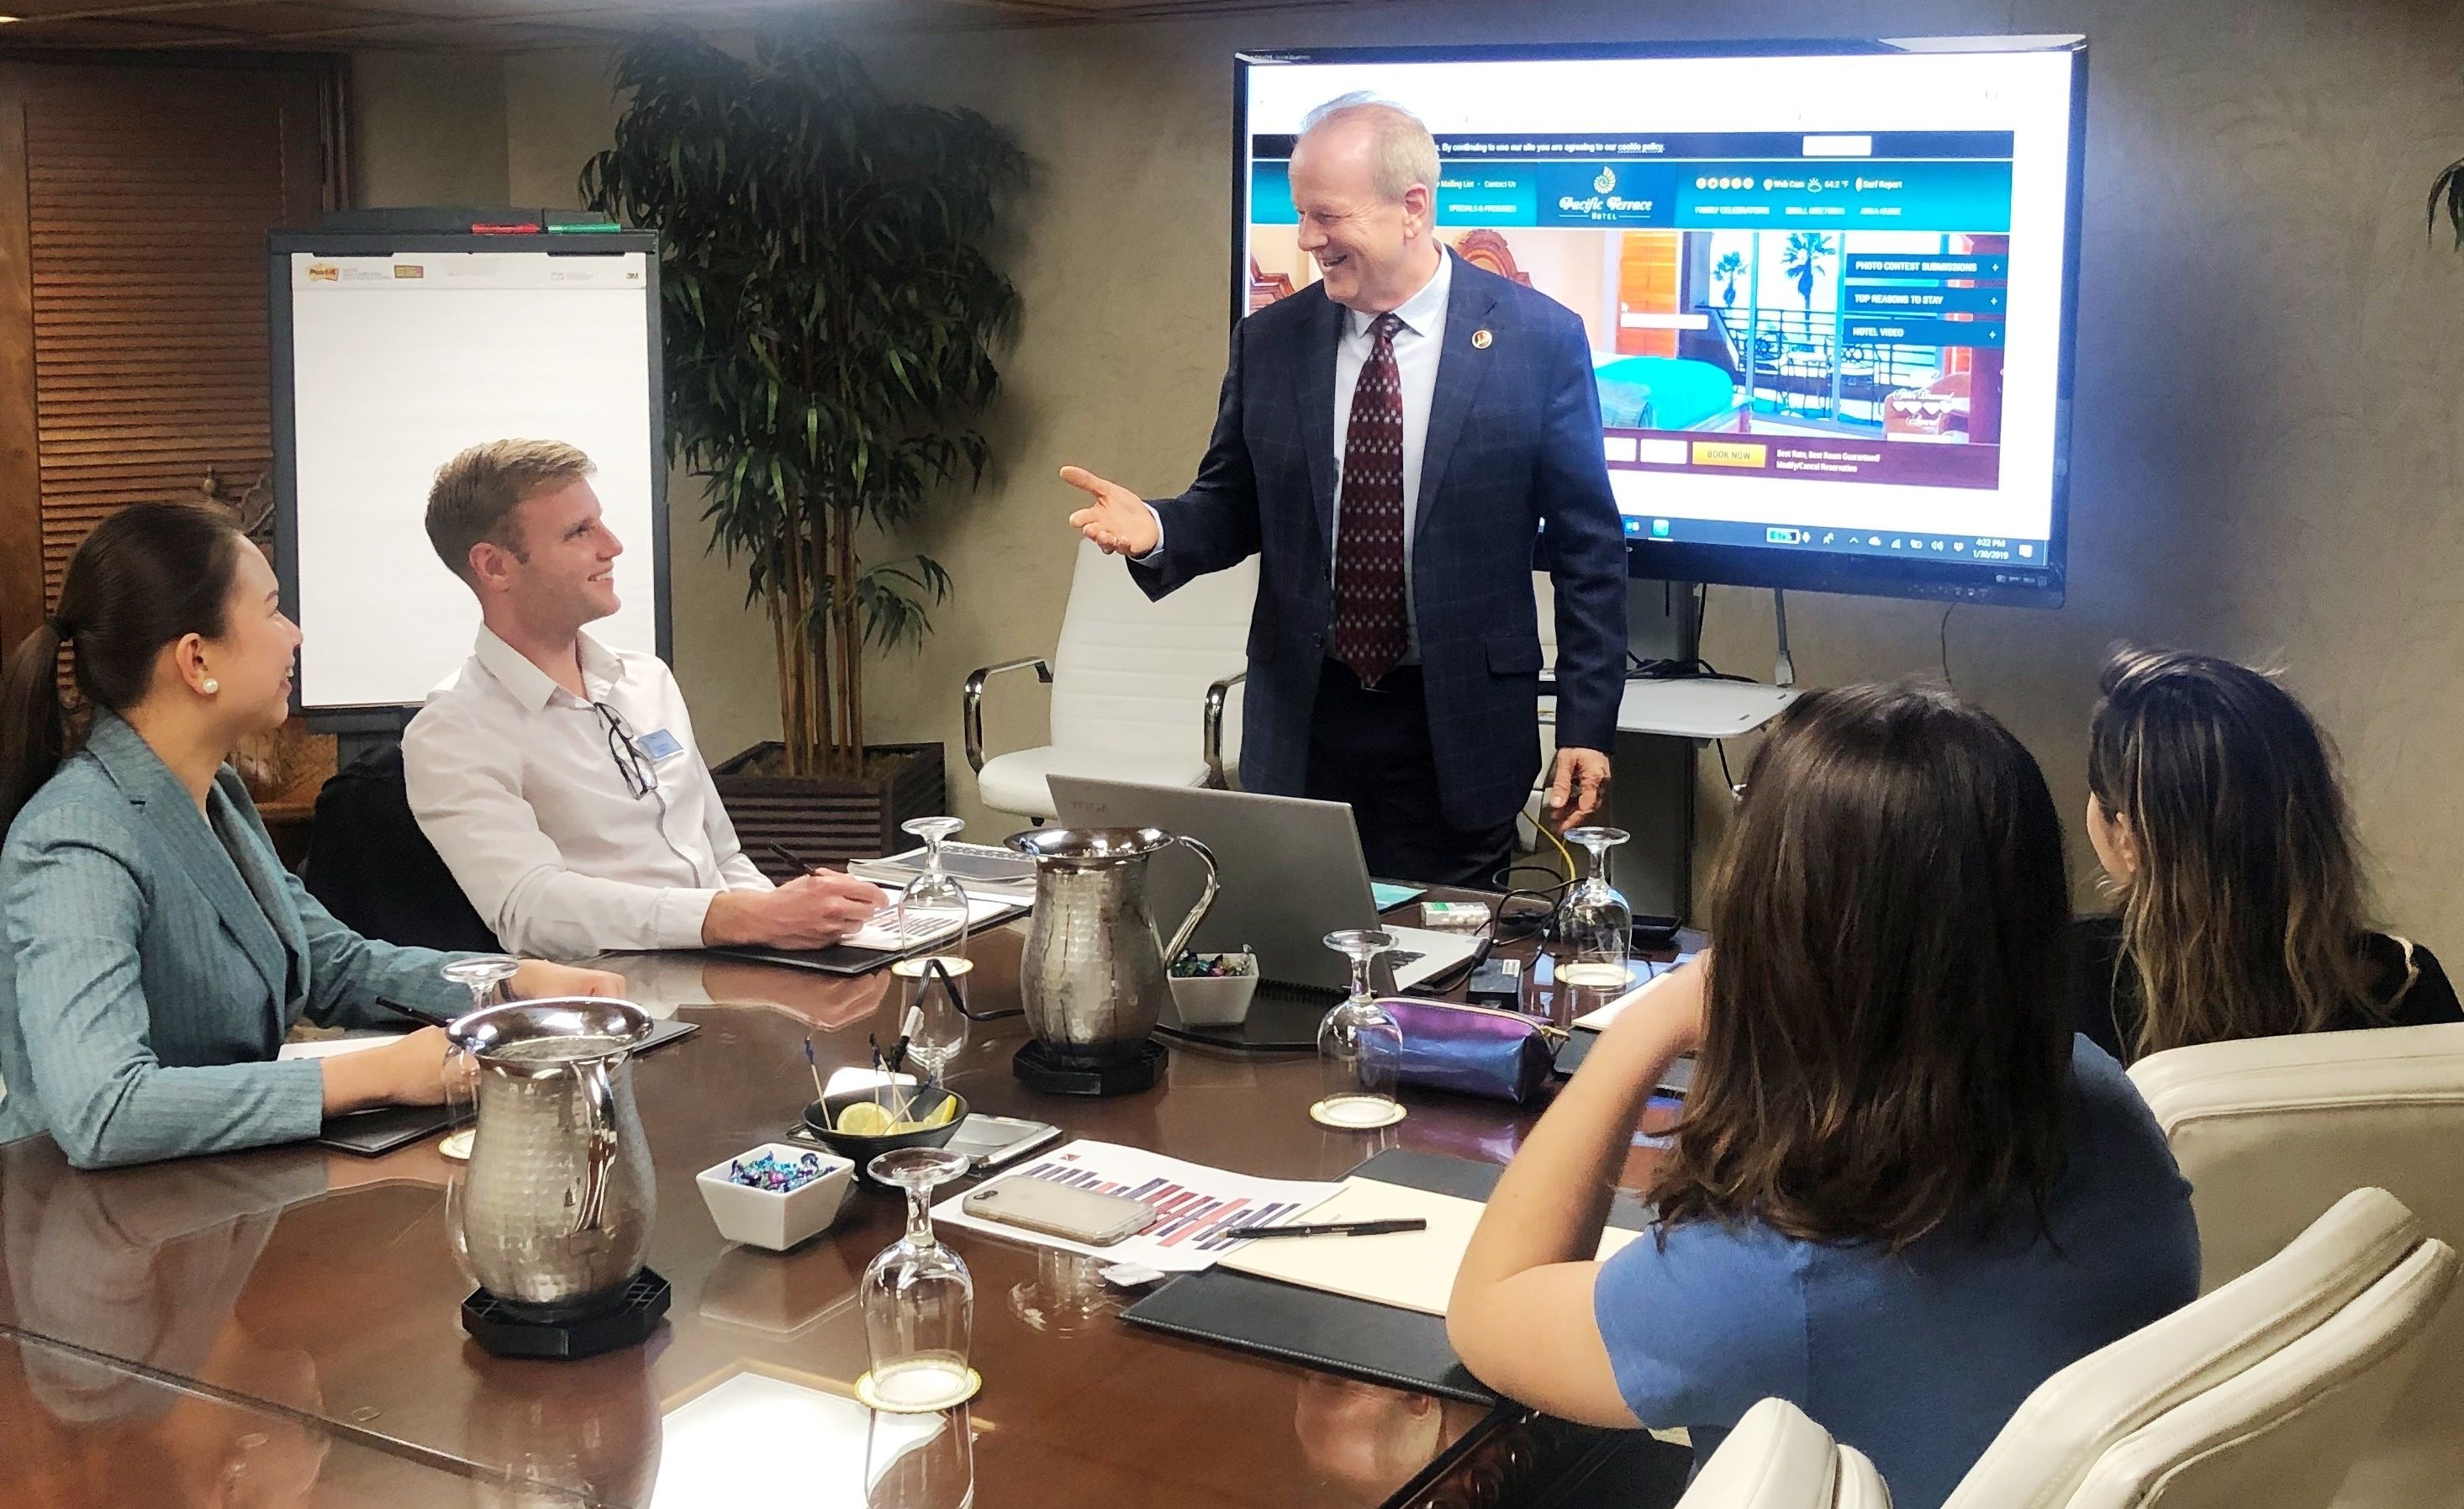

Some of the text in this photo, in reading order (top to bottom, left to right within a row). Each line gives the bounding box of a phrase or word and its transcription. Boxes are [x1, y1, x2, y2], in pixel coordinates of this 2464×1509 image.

[1442, 143, 1452, 153] By
[1453, 143, 1487, 153] continuing
[1523, 143, 1536, 151] site
[1537, 145, 1550, 153] you
[1564, 143, 1595, 153] agreeing
[1617, 143, 1641, 151] cookie
[1642, 143, 1665, 153] policy.
[1440, 179, 1463, 189] Mailing
[1774, 180, 1789, 188] Web
[1863, 180, 1902, 189] Surf Report
[1559, 196, 1653, 213] Pacific Terrace
[1855, 261, 1977, 272] PHOTO CONTEST SUBMISSIONS
[1854, 293, 1944, 304] TOP REASONS TO STAY
[1852, 327, 1904, 337] HOTEL VIDEO
[1707, 450, 1751, 460] BOOK NOW
[1776, 449, 1791, 458] Best
[1808, 451, 1823, 460] Best
[1823, 451, 1843, 461] Room
[1820, 462, 1858, 473] Reservation
[1976, 538, 2006, 549] 4:22 PM
[1972, 549, 2009, 561] 1/30/2019
